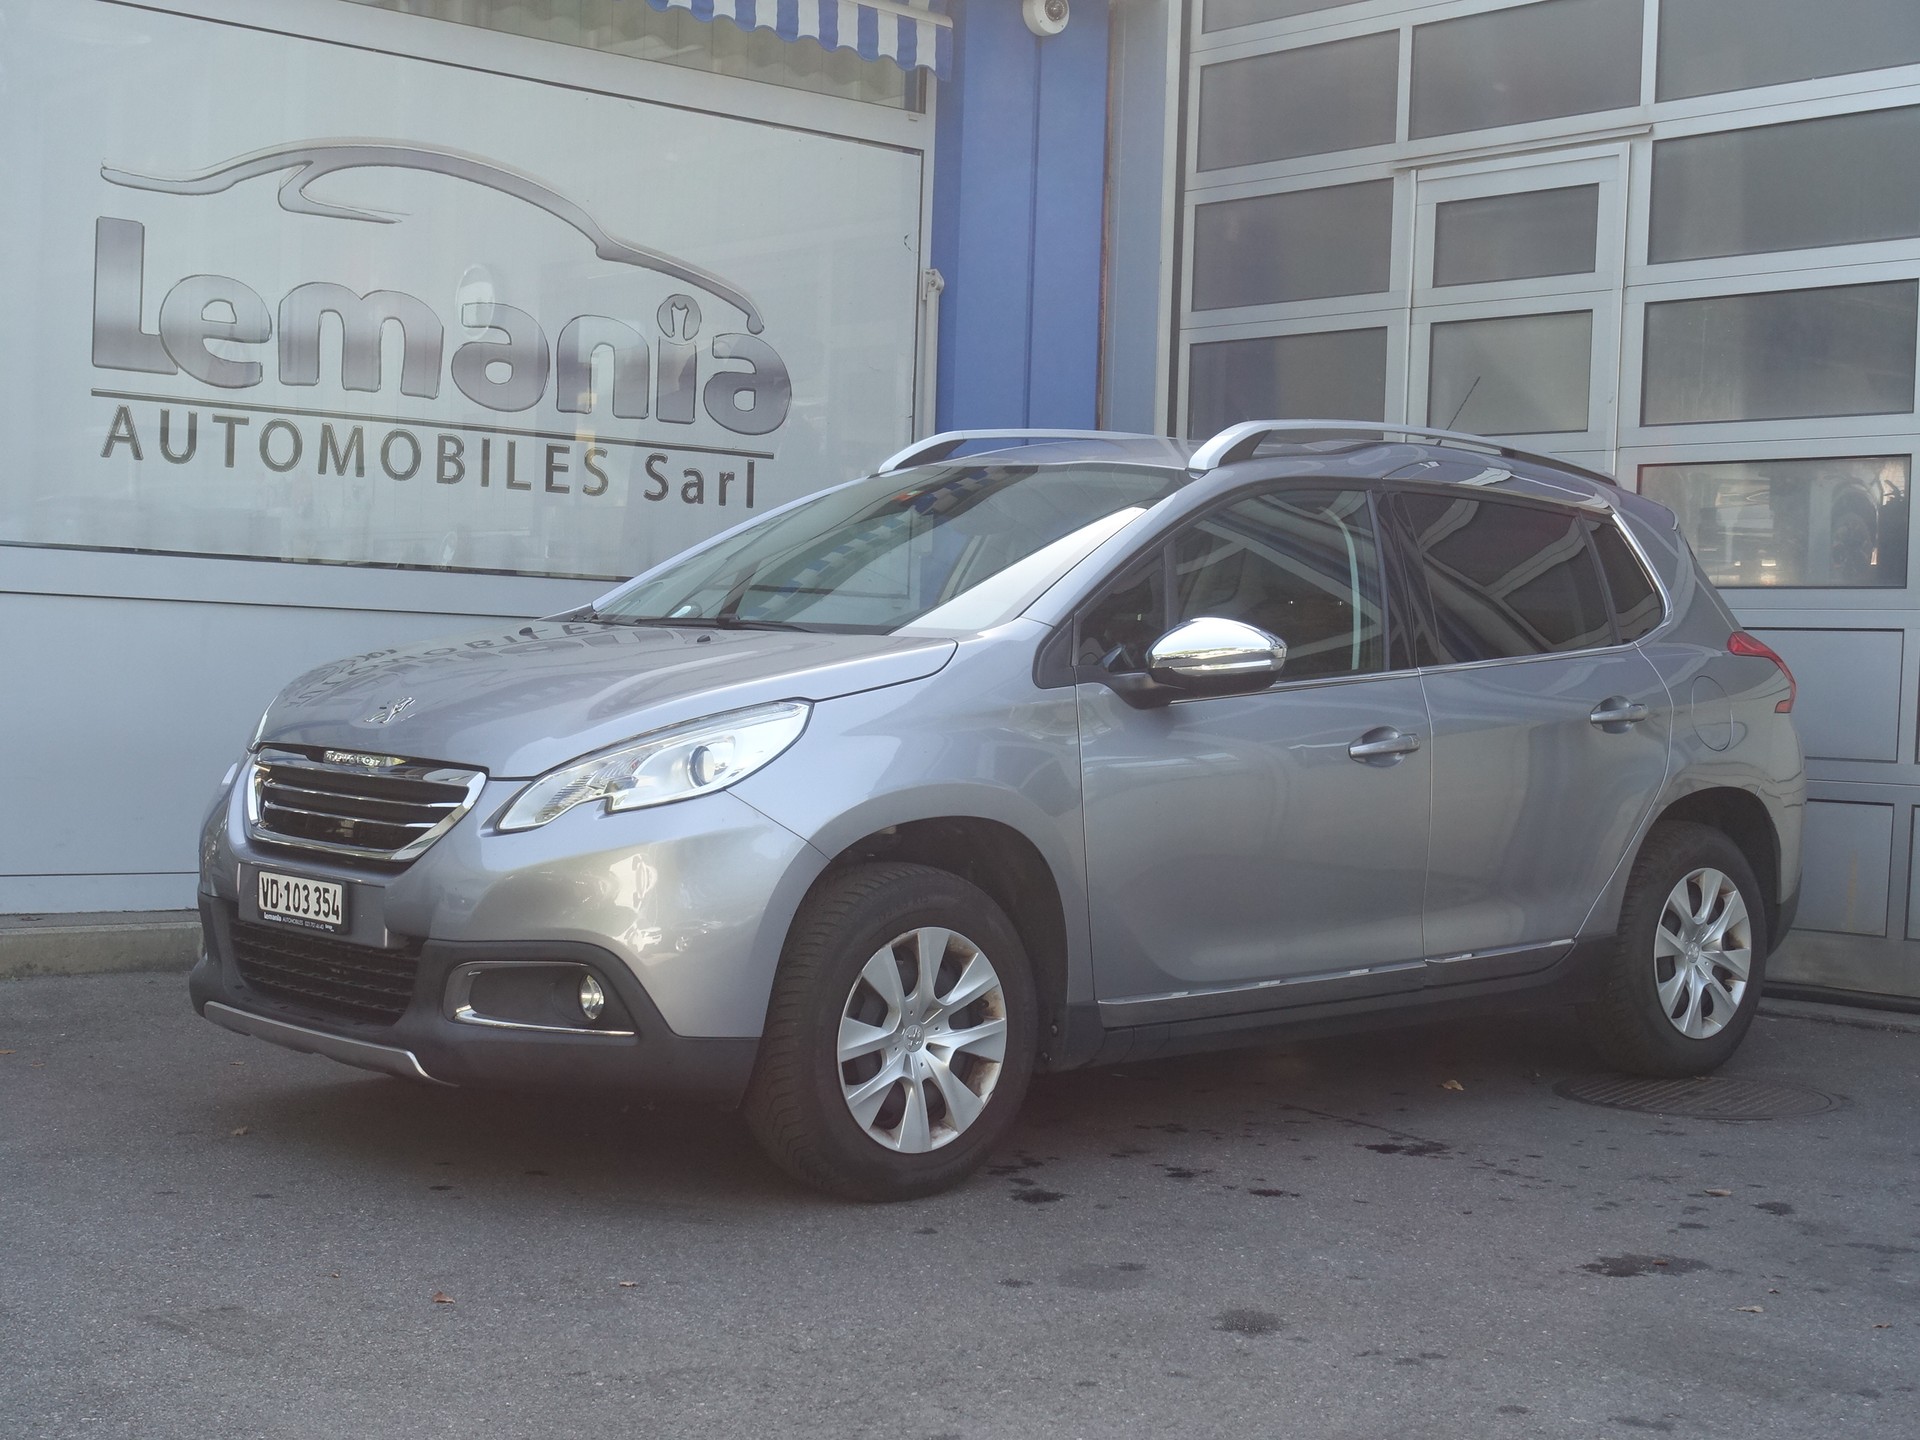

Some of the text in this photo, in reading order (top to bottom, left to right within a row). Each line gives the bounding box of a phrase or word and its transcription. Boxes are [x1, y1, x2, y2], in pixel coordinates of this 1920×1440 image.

[92, 217, 792, 435] Lemania
[101, 405, 756, 509] AUTOMOBILES Sarl
